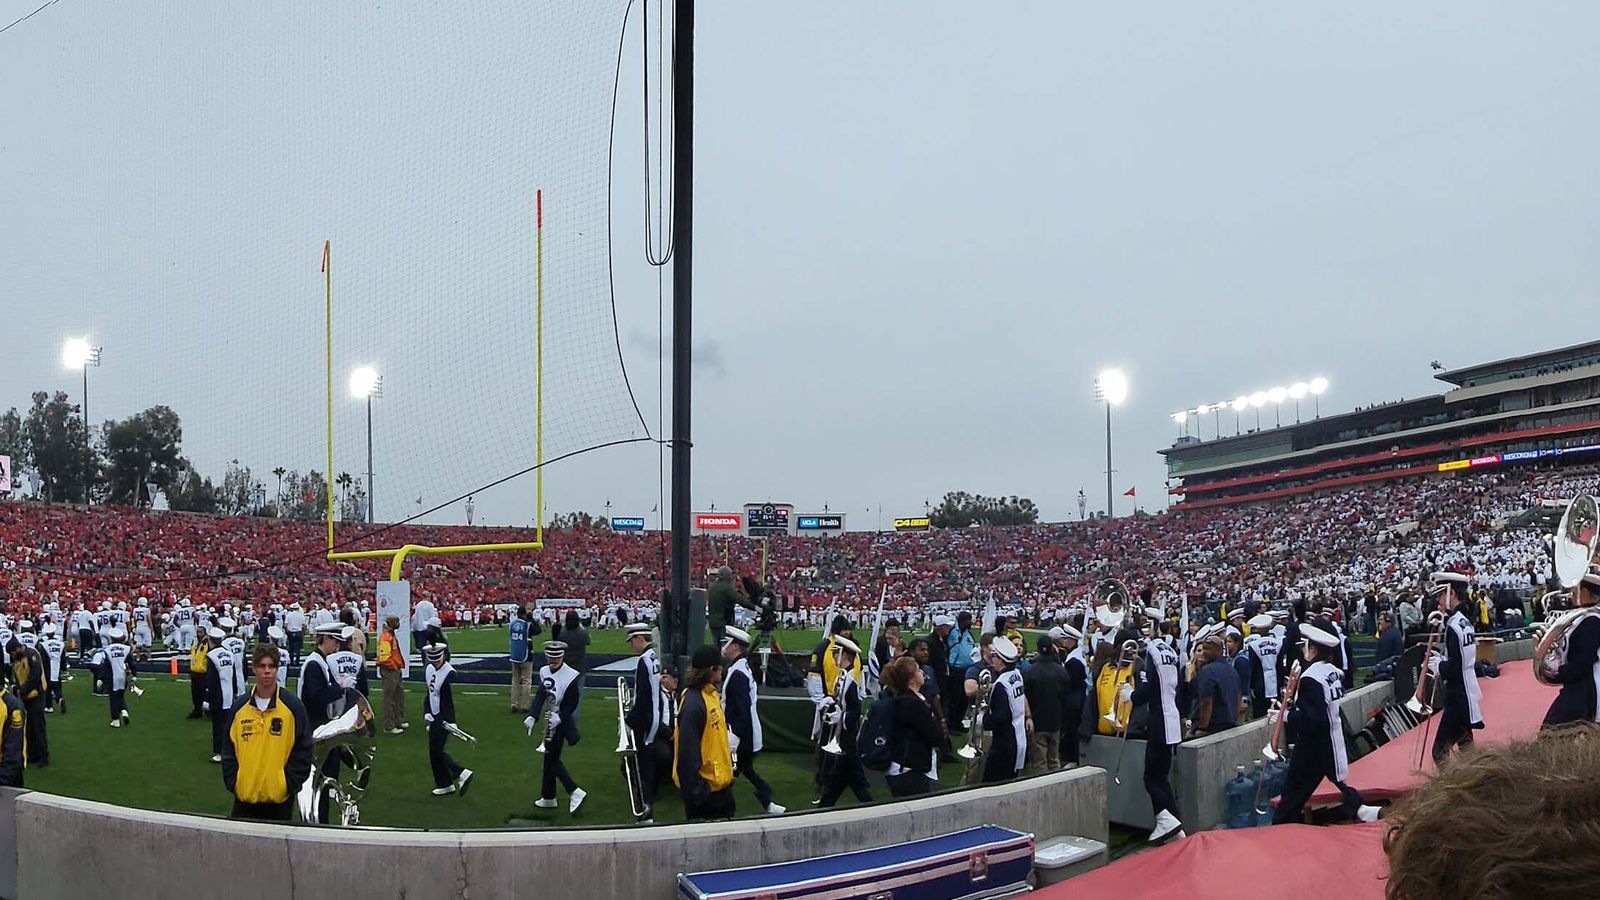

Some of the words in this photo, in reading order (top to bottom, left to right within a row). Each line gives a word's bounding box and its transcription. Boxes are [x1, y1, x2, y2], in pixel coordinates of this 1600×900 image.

[700, 518, 737, 526] HONDA
[819, 519, 840, 527] Health
[135, 610, 145, 621] 75
[178, 609, 190, 621] 79
[1260, 647, 1278, 656] LIONS
[336, 654, 358, 665] NITTANY
[338, 663, 358, 675] LIONS
